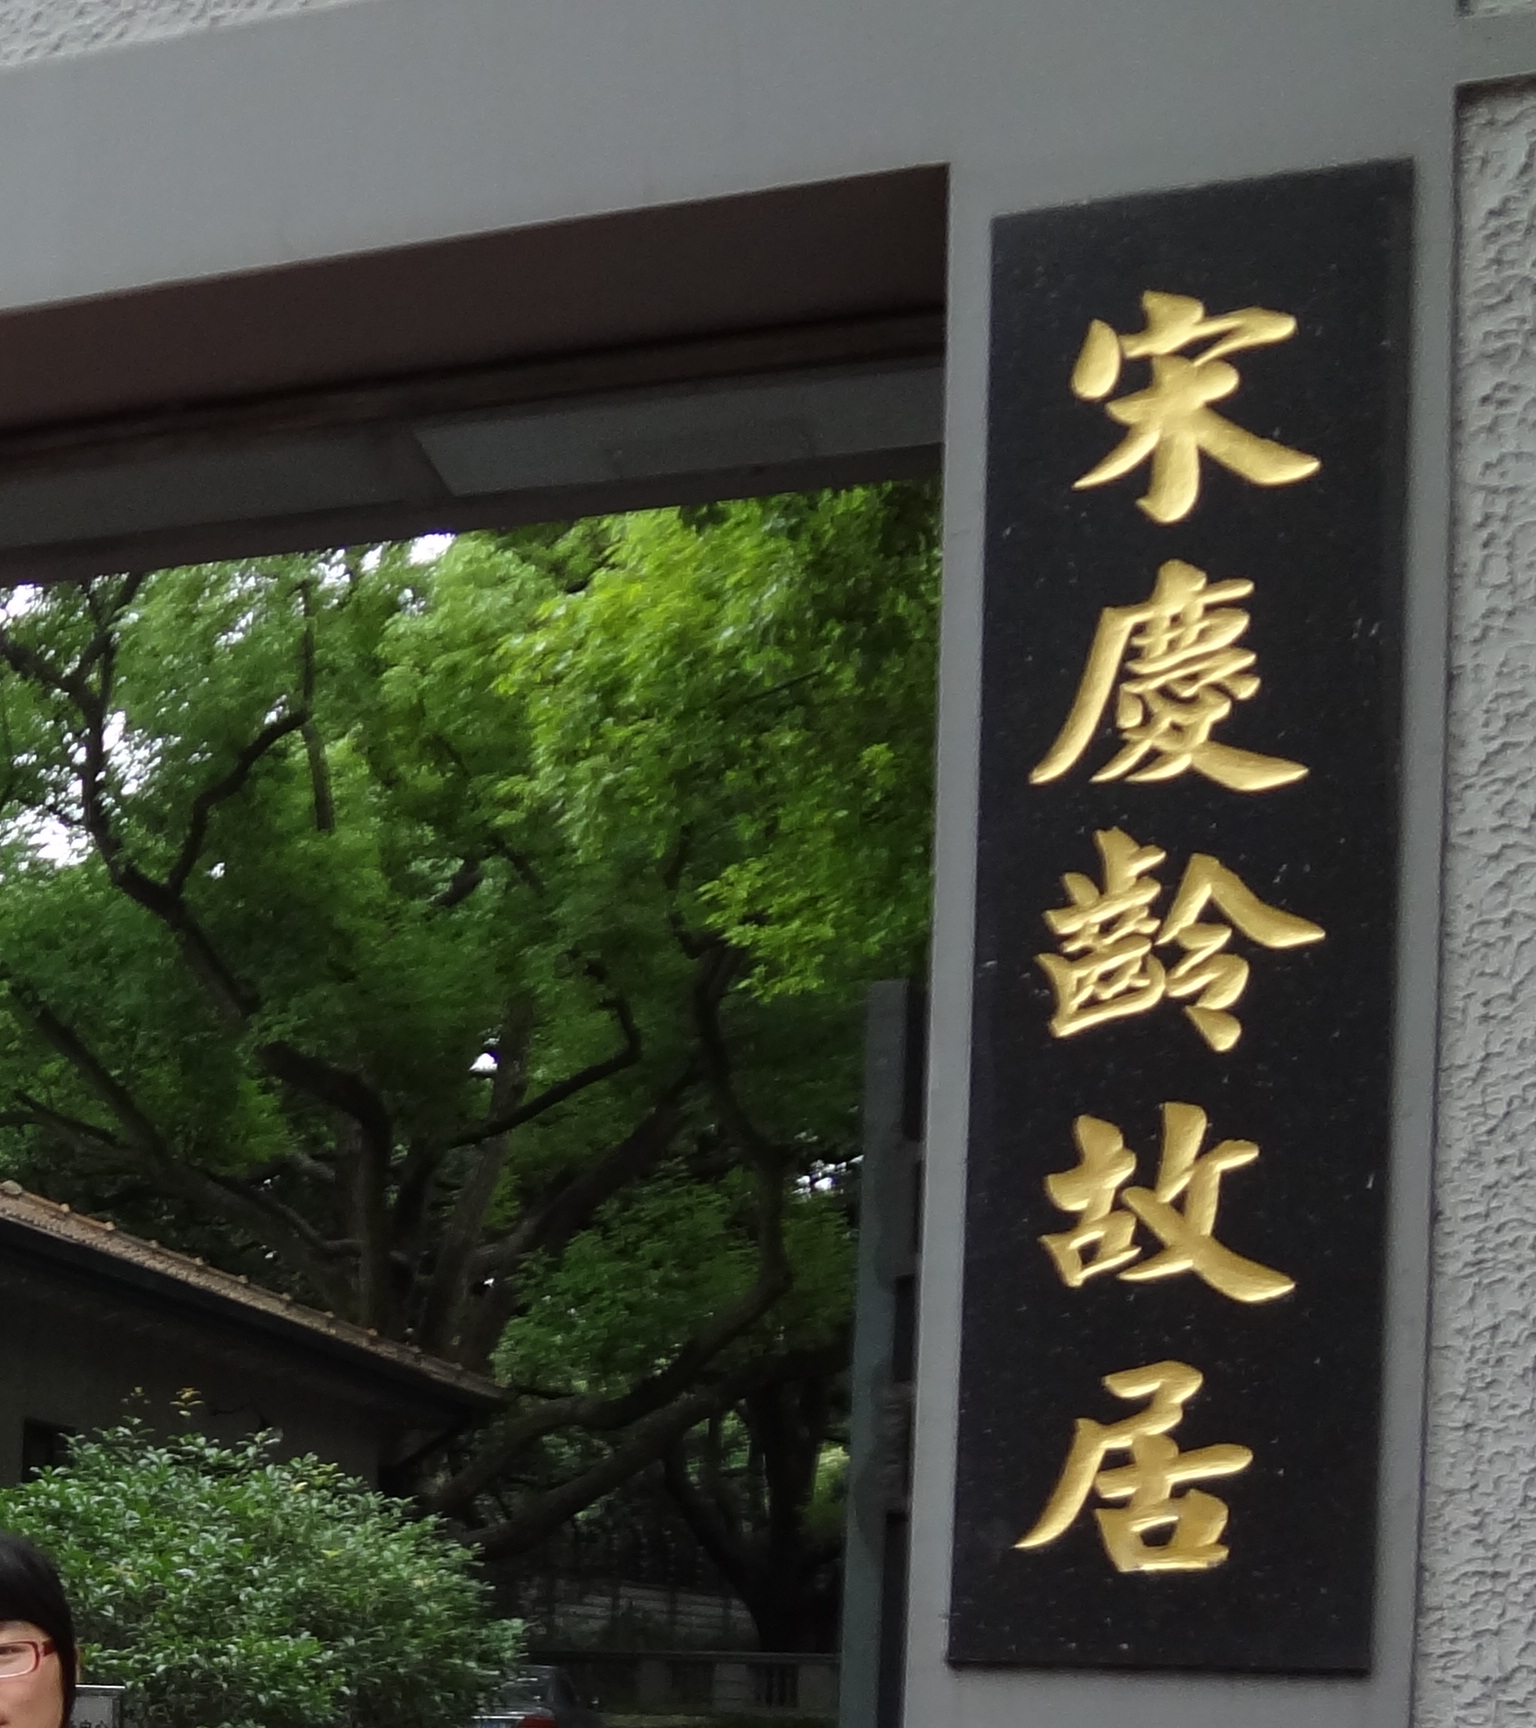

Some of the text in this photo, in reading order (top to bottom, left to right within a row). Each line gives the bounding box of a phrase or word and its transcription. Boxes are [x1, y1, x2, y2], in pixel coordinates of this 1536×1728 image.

[1014, 290, 1325, 1572] 宋慶齡故居
